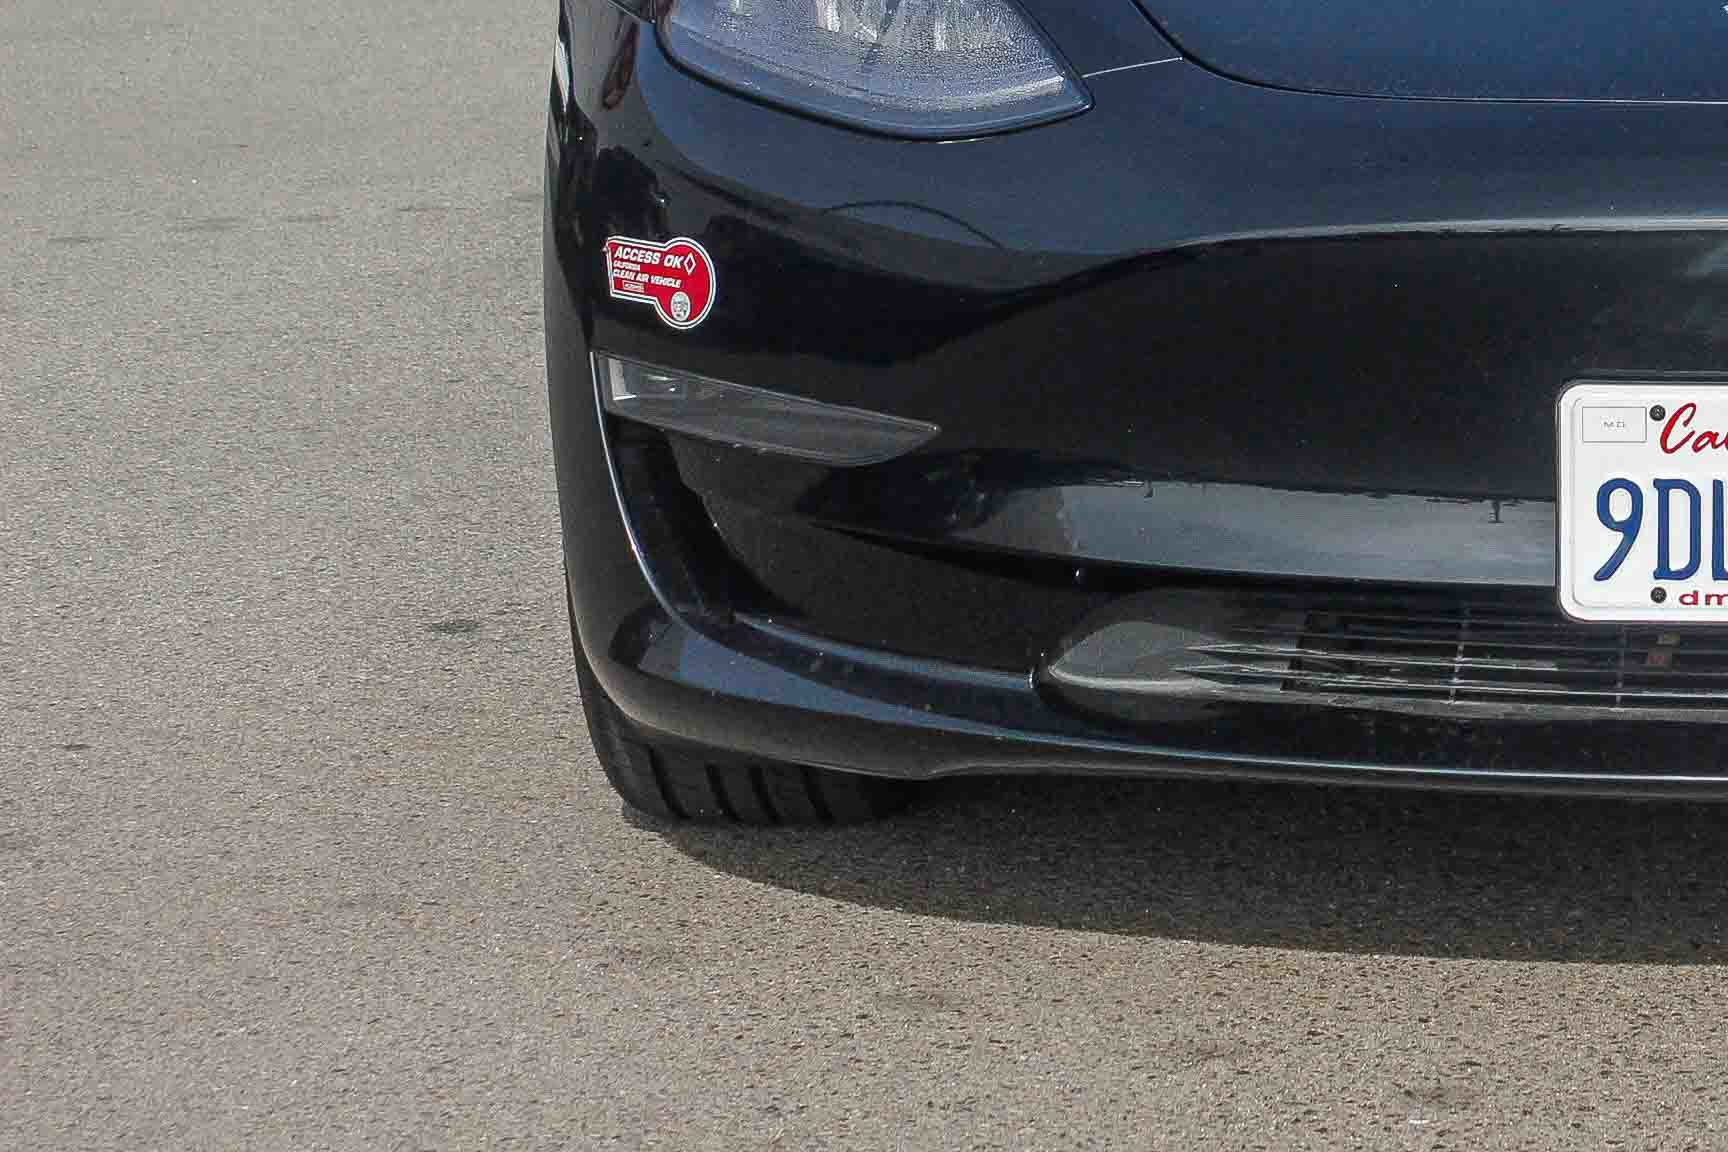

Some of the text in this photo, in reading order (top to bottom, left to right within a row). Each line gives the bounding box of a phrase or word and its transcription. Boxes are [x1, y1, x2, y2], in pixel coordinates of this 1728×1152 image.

[614, 245, 685, 268] ACCESS OK
[613, 268, 636, 281] CLEAN
[651, 275, 682, 289] VEHICLE
